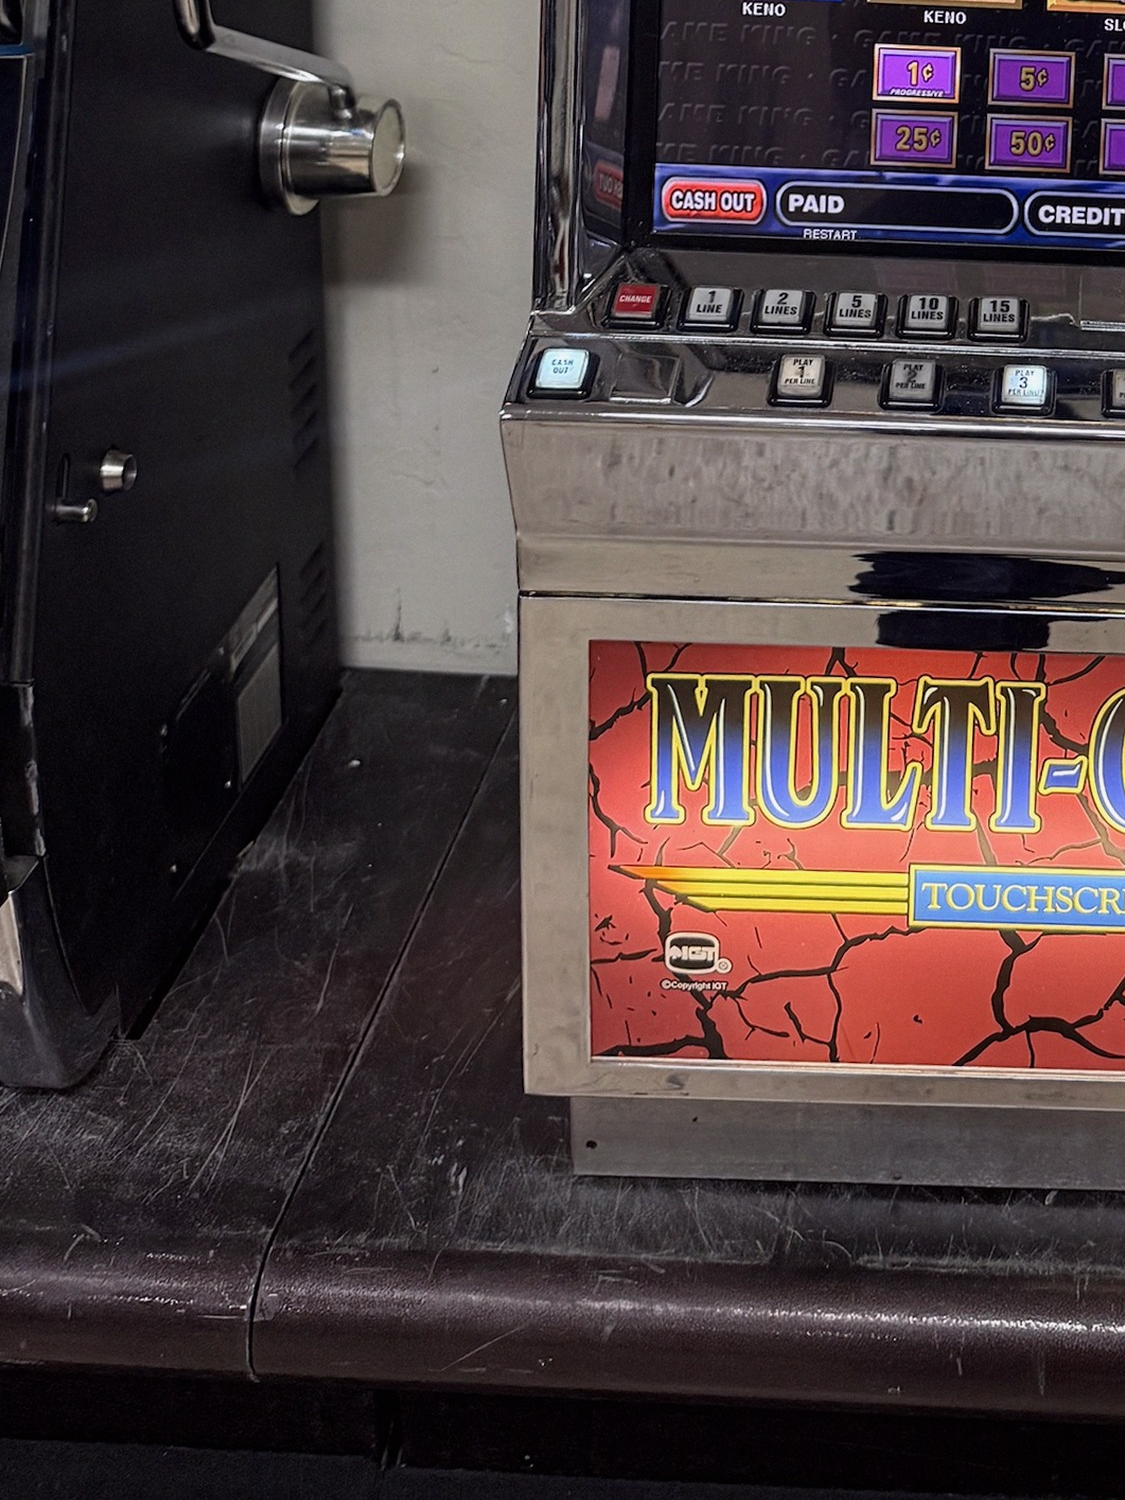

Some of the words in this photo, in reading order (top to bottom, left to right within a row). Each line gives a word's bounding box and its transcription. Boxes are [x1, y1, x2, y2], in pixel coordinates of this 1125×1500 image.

[742, 2, 785, 17] KENO
[923, 10, 967, 25] KENO
[906, 61, 933, 86] 1¢
[1019, 67, 1049, 91] 5¢
[889, 87, 944, 98] PROGRESSIVE
[896, 126, 942, 152] 25¢
[1010, 131, 1056, 157] 50¢
[671, 190, 716, 212] CASH
[721, 191, 755, 213] OUT
[788, 194, 845, 214] PAID
[1038, 204, 1125, 227] CREDIT
[803, 228, 857, 241] RESTART
[619, 294, 652, 303] CHANGE
[708, 291, 716, 303] 1
[778, 292, 789, 305] 2
[852, 295, 862, 308] 5
[696, 304, 722, 314] LINE
[919, 297, 938, 310] 10
[990, 300, 1010, 313] 15
[764, 305, 797, 315] LINES
[839, 308, 871, 318] LINES
[911, 310, 944, 320] LINES
[983, 313, 1015, 323] LINES
[793, 358, 813, 366] PLAY
[903, 364, 923, 372] PLAY
[553, 366, 569, 374] OUT
[1015, 369, 1035, 377] PLAY
[895, 381, 910, 389] PER
[911, 382, 926, 390] LINE
[1019, 377, 1028, 389] 3
[681, 946, 715, 961] IGT
[712, 982, 727, 990] IGT
